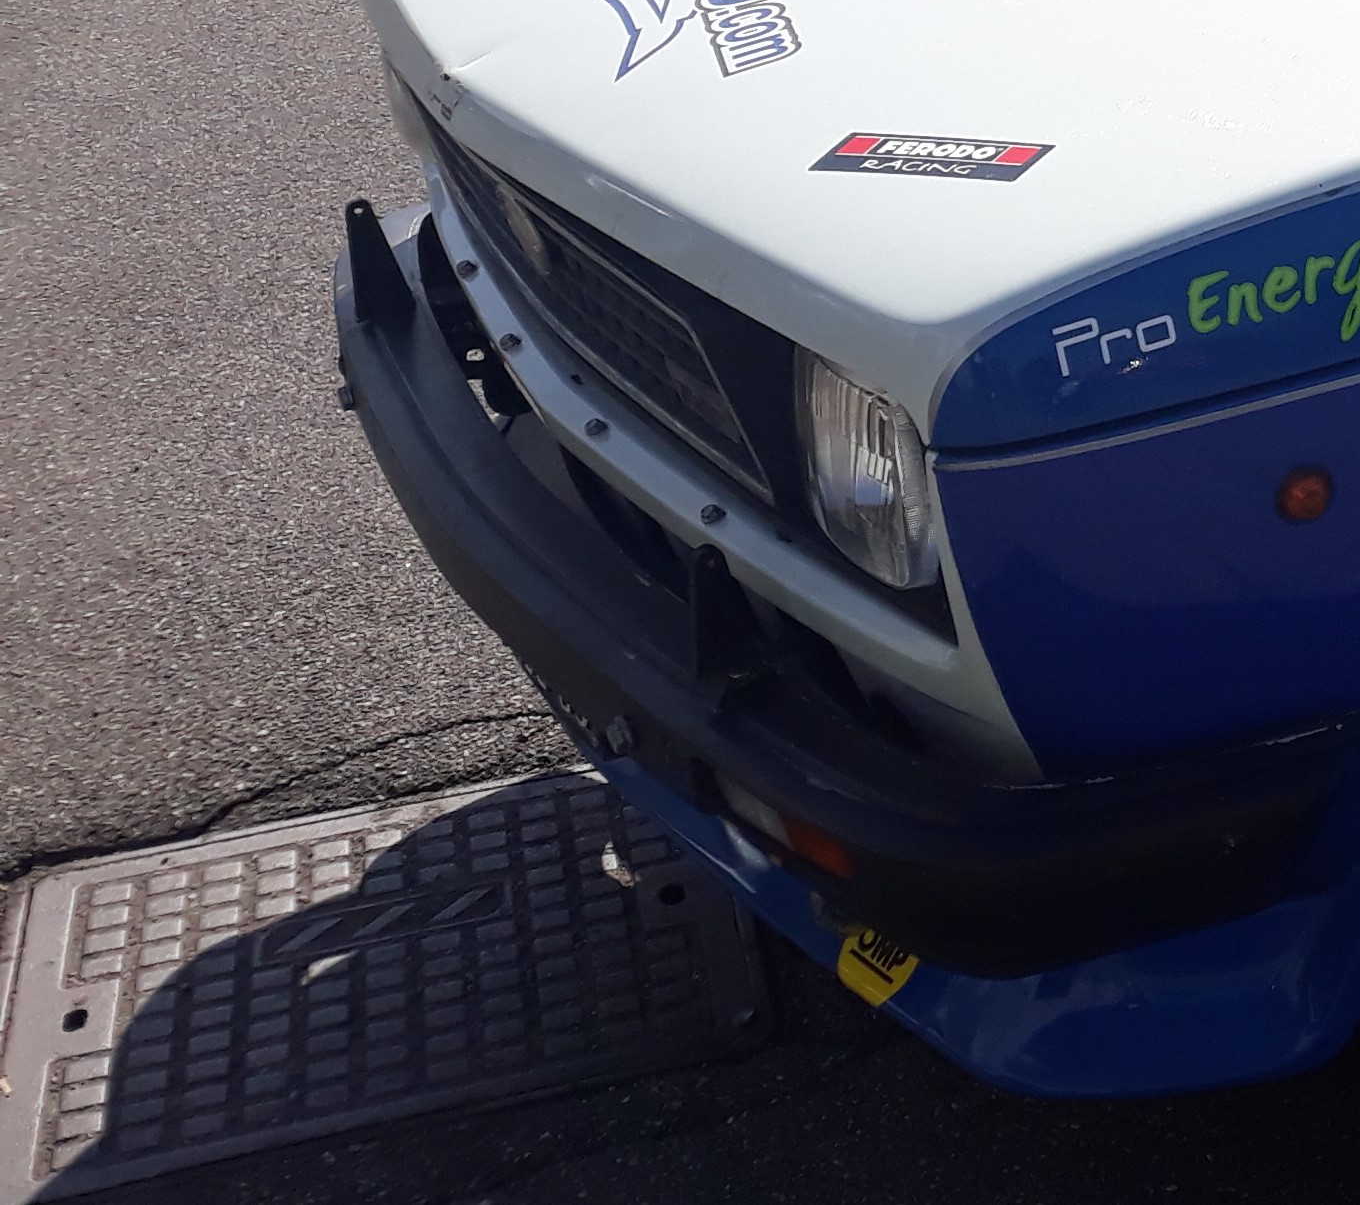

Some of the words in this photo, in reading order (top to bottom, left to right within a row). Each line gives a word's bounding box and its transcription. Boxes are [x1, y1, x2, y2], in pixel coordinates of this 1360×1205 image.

[876, 140, 997, 160] FERODO
[859, 159, 978, 175] RACING
[1052, 314, 1177, 378] Pro
[857, 926, 910, 972] OMP
